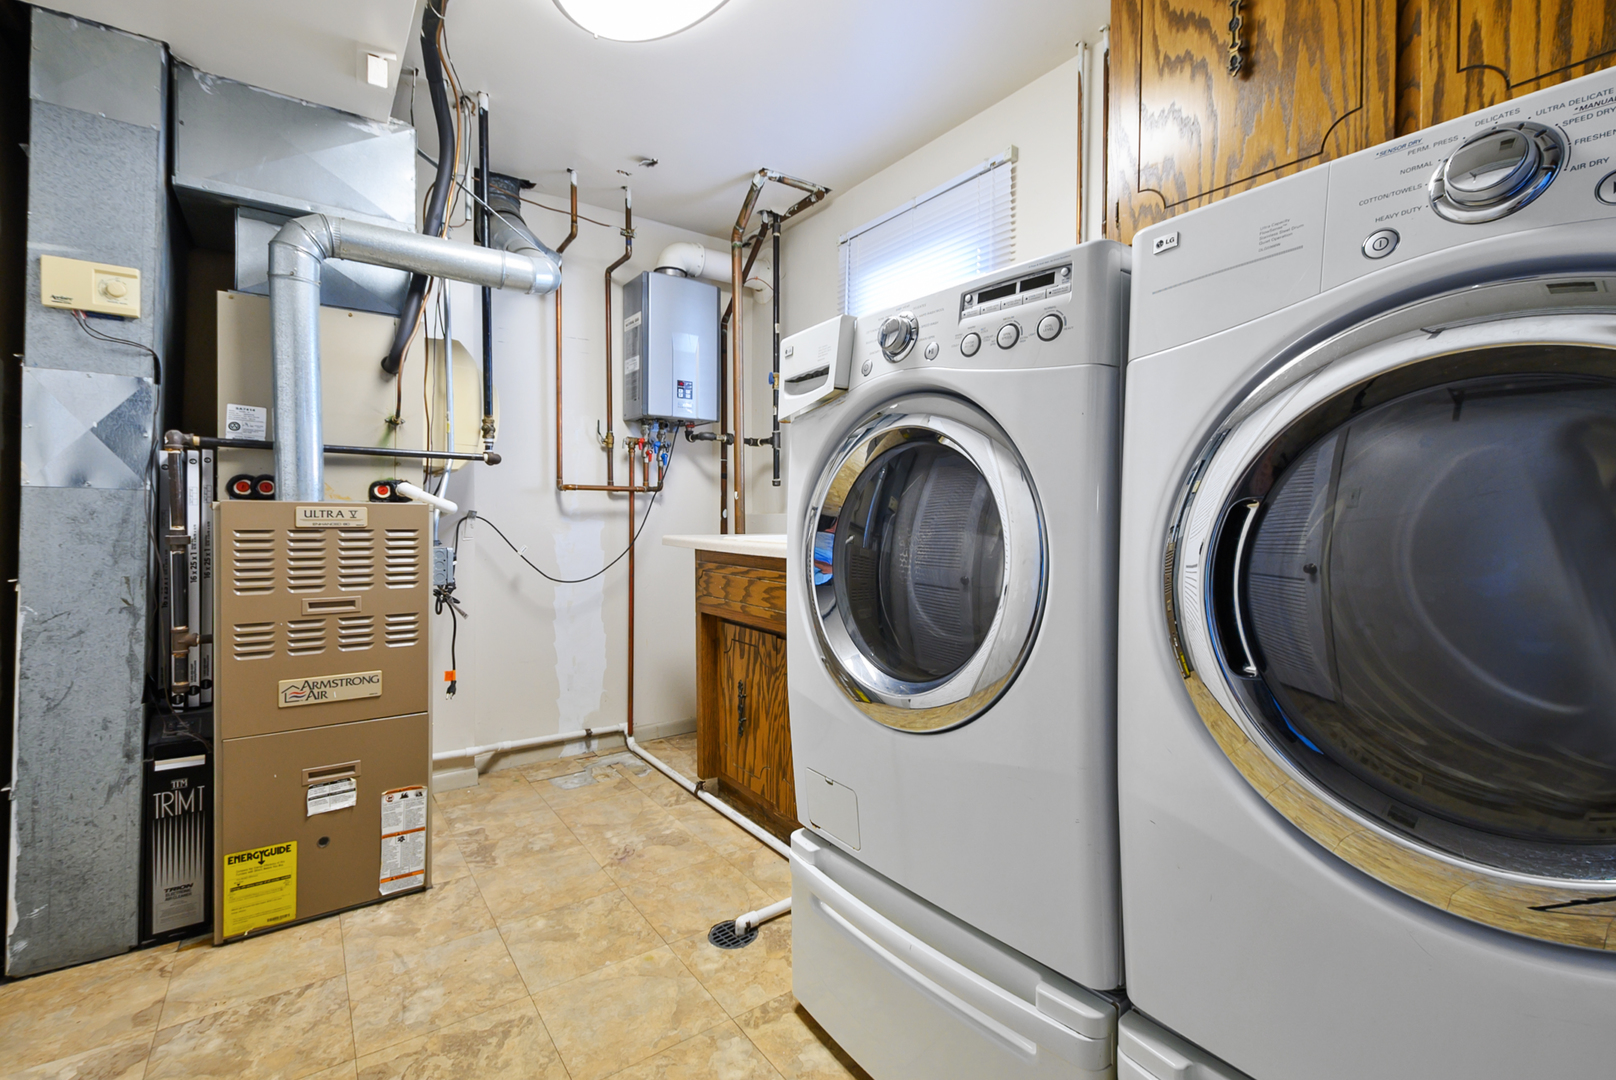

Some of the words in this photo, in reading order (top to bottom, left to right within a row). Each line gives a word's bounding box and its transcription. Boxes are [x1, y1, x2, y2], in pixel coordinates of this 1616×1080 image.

[1535, 102, 1566, 117] ULTRA
[1568, 87, 1615, 107] DELICATE
[1474, 108, 1521, 127] DELICATES
[1562, 111, 1594, 127] SPEED
[1596, 106, 1616, 118] DRY
[1378, 142, 1406, 157] SENSOR
[1407, 138, 1423, 148] DRY
[1407, 144, 1431, 156] PERM.
[1432, 134, 1459, 148] PRESS
[1399, 160, 1433, 176] NORMAL
[1569, 162, 1586, 172] AIR
[1588, 156, 1610, 168] DRY
[1358, 182, 1423, 206] COTTON/TOWELS
[1374, 211, 1400, 223] HEAVY
[1400, 205, 1423, 218] DUTY
[304, 509, 344, 518] ULTRA
[348, 510, 358, 518] V
[190, 562, 197, 570] 25
[204, 557, 210, 566] 25
[300, 674, 380, 692] ARMSTRONG
[305, 690, 328, 701] AIR
[152, 787, 195, 820] TRIM
[197, 785, 206, 812] T
[228, 844, 292, 865] ENERGYGUIDE
